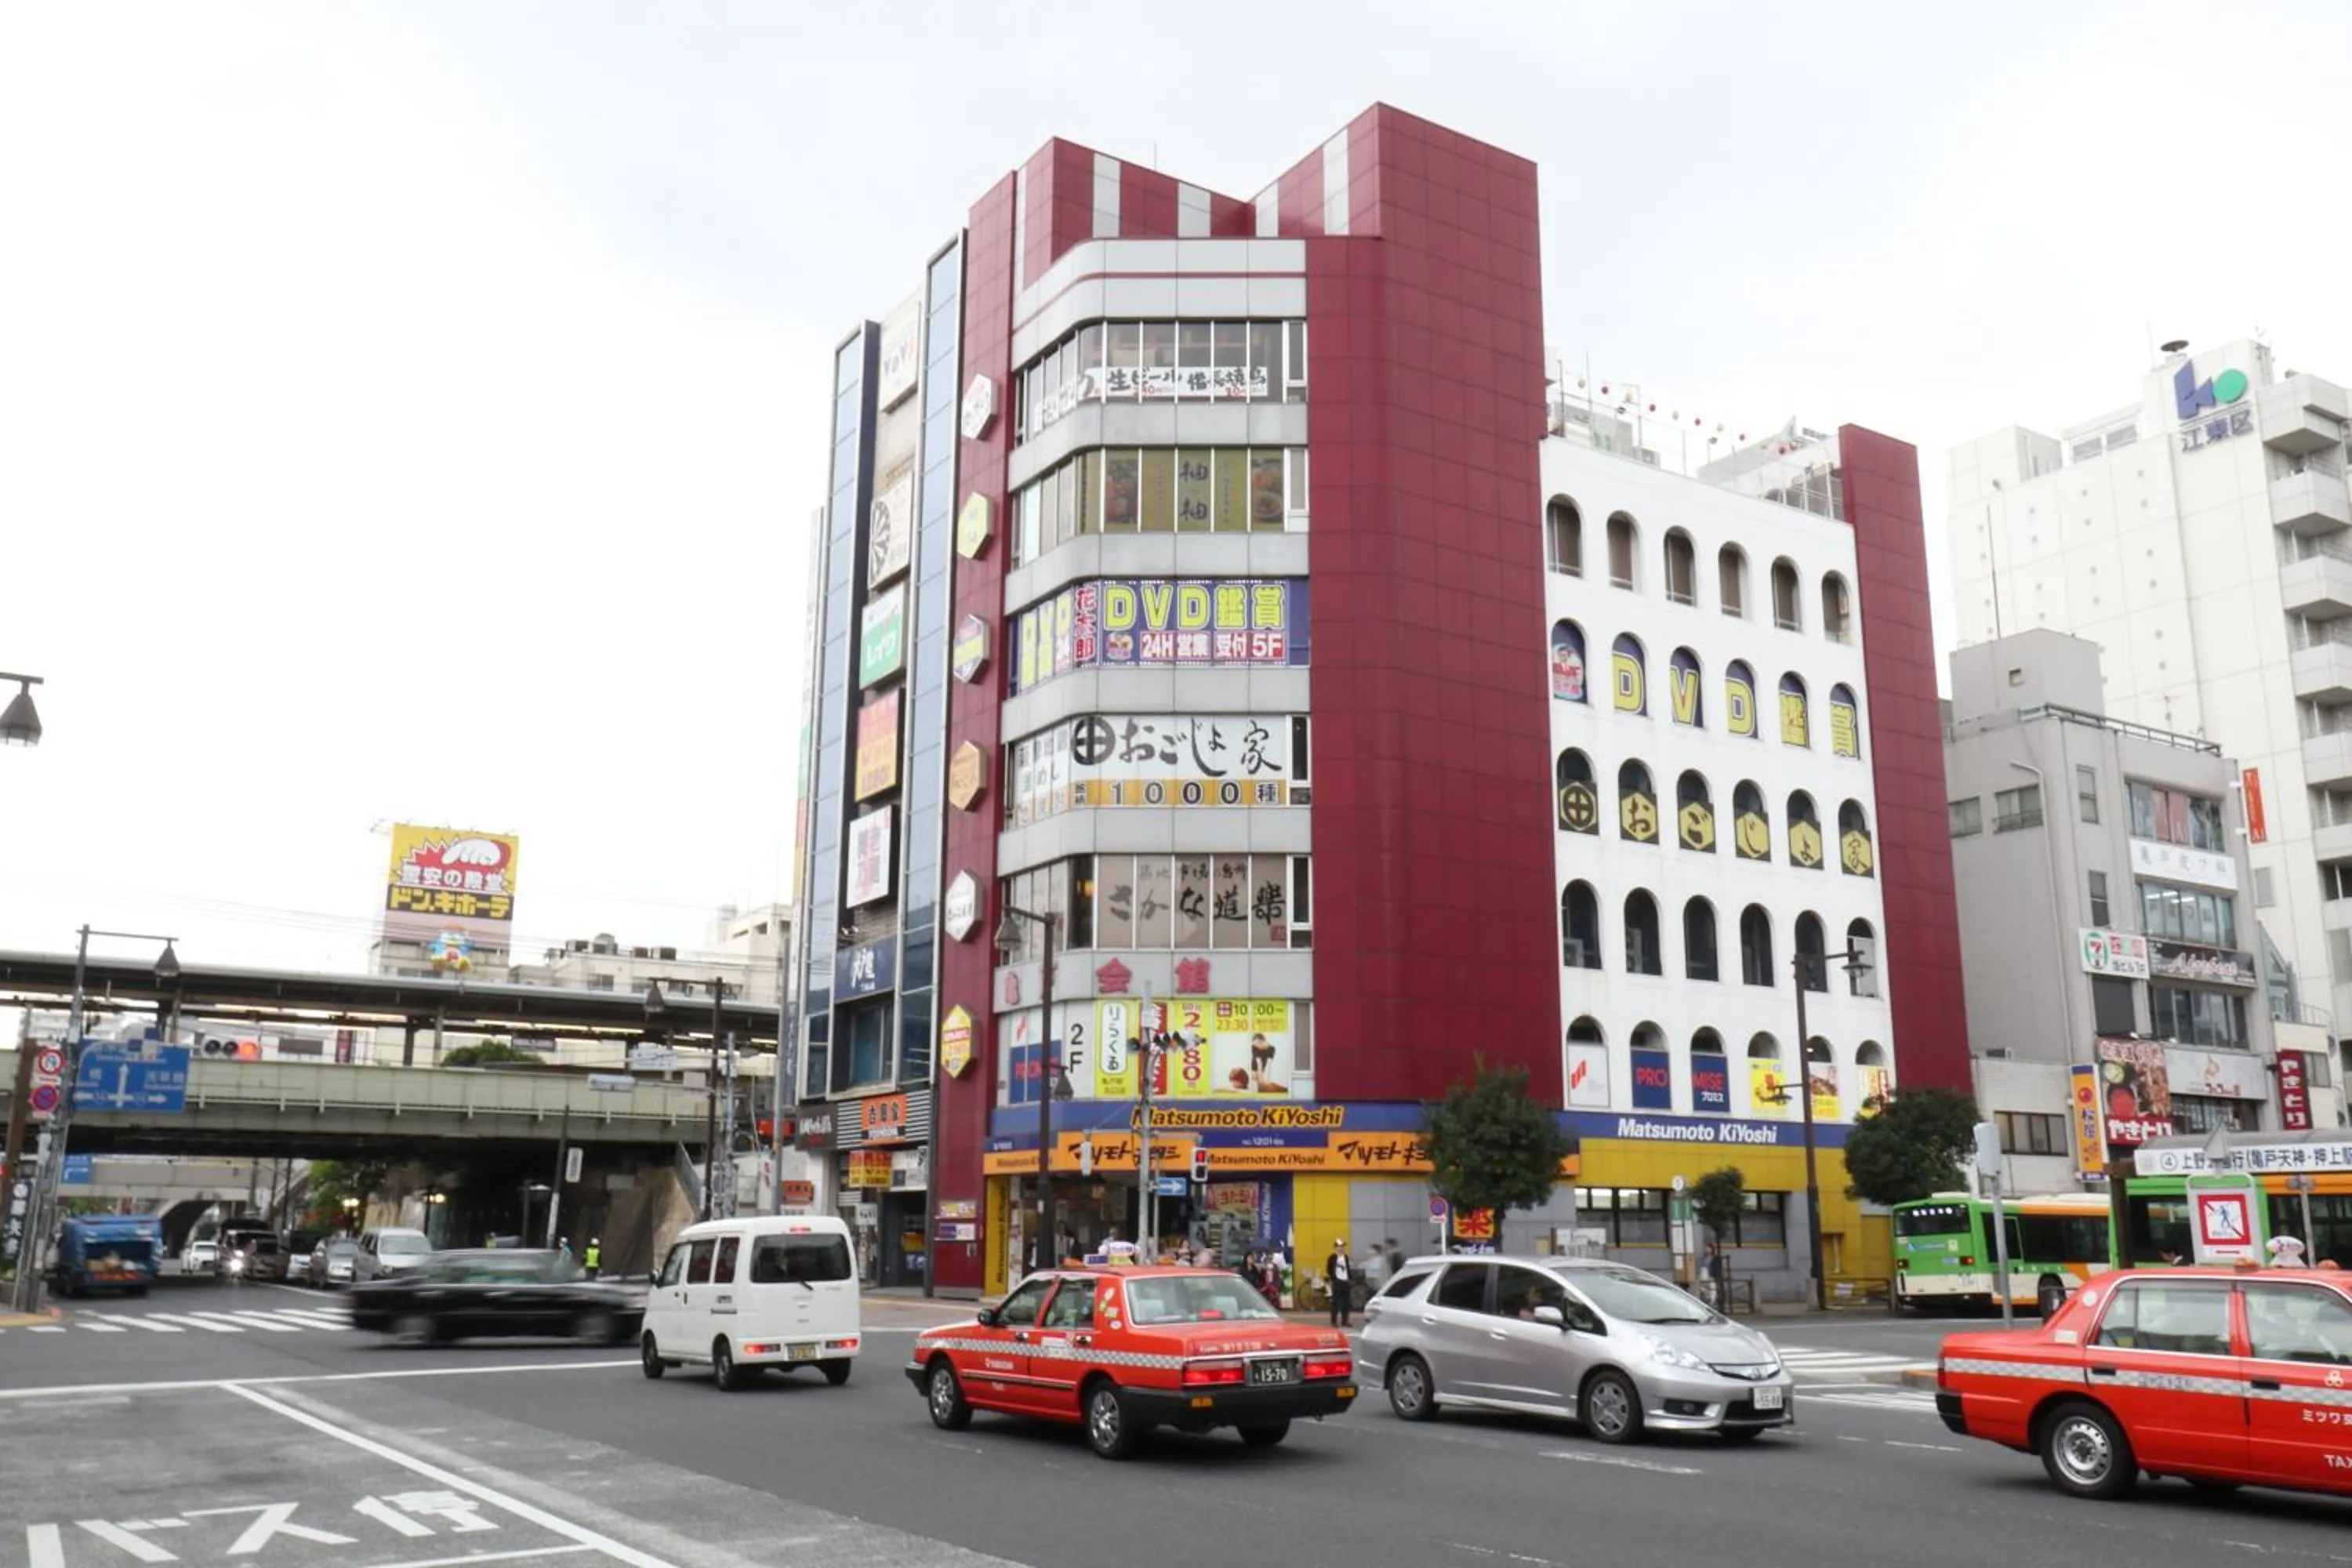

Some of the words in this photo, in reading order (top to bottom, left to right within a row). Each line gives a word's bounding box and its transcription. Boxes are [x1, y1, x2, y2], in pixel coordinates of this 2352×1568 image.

[1636, 1066, 1668, 1088] PRO
[1692, 1071, 1723, 1091] MISE
[1261, 1105, 1343, 1127] KiYoshi
[1617, 1117, 1715, 1143] Matsumoto
[1719, 1124, 1778, 1145] KiYoshi
